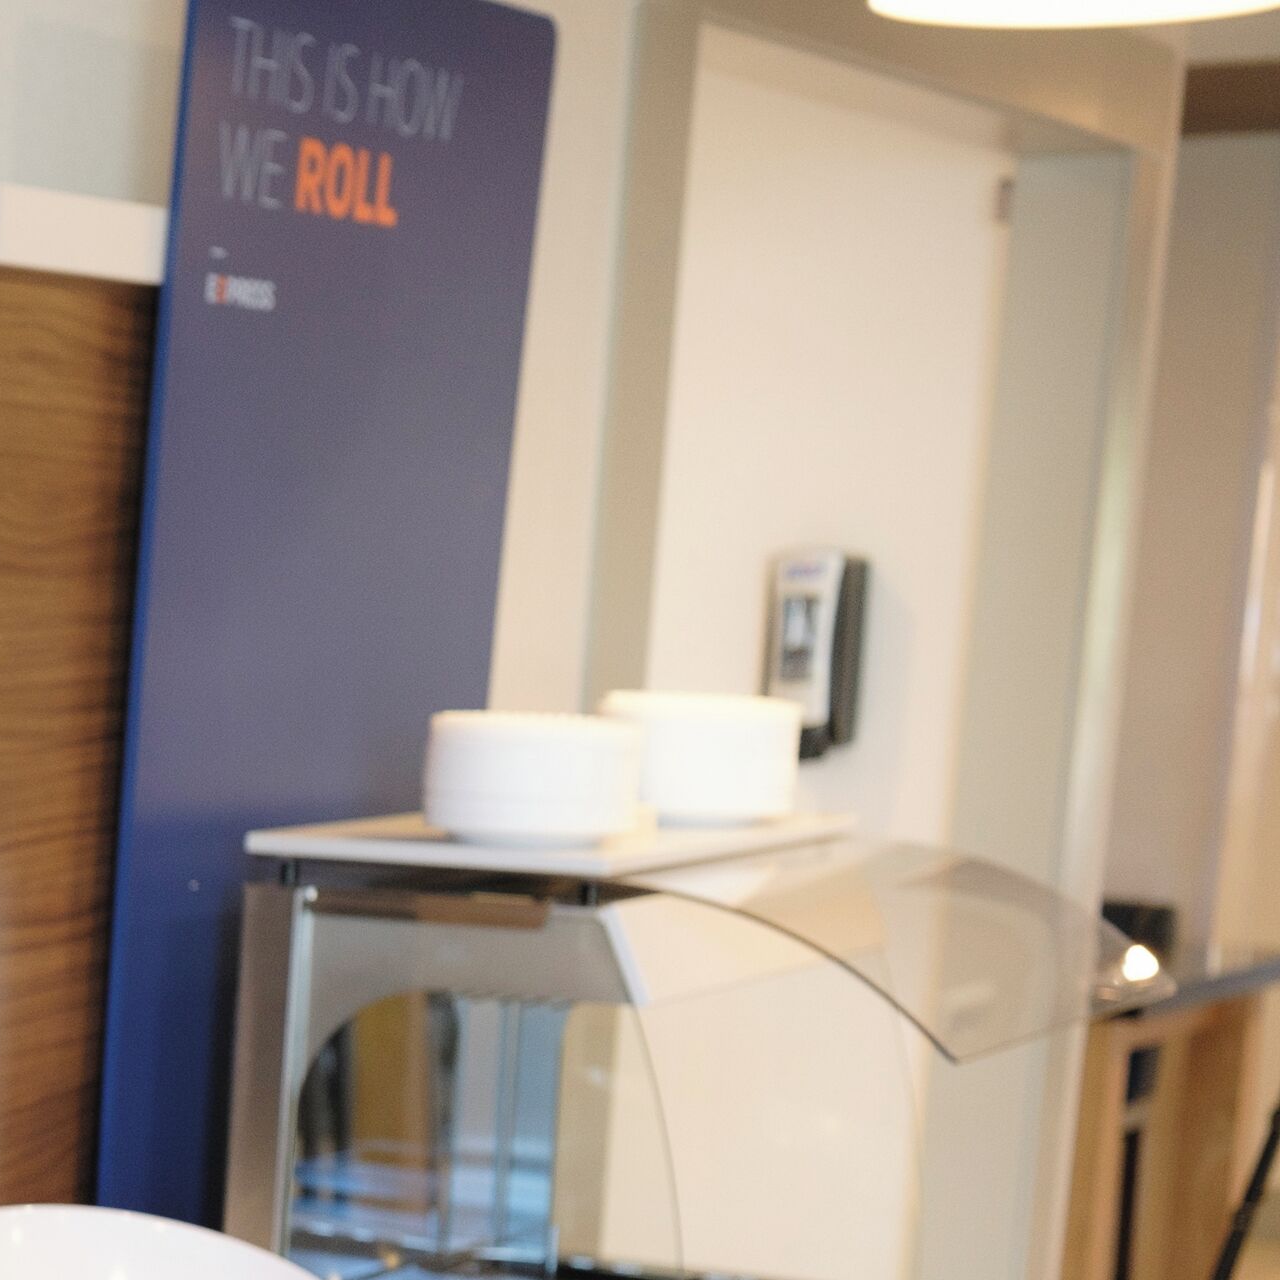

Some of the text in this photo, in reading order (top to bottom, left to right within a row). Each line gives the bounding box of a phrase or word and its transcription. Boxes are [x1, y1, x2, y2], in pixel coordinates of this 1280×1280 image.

[230, 14, 466, 142] THIS IS HOW
[217, 119, 400, 229] WE ROLL
